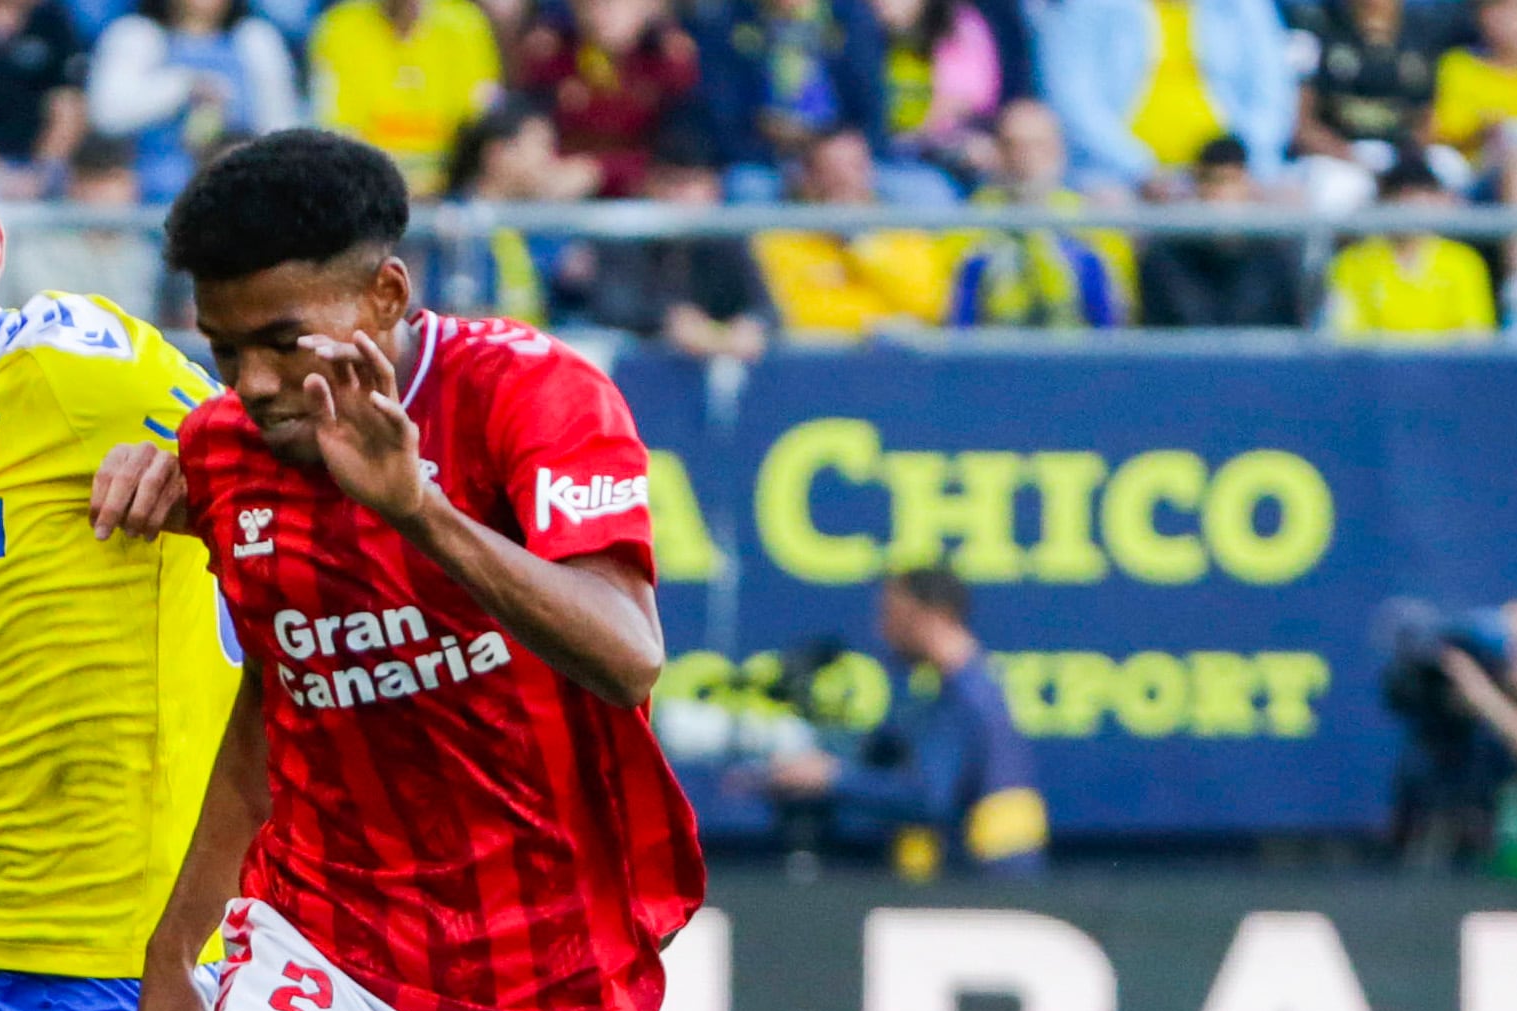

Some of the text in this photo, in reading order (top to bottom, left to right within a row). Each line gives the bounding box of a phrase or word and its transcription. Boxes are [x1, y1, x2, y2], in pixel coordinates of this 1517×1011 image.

[754, 417, 1335, 585] CHICO
[273, 605, 430, 660] Gran
[277, 630, 512, 709] Canaria
